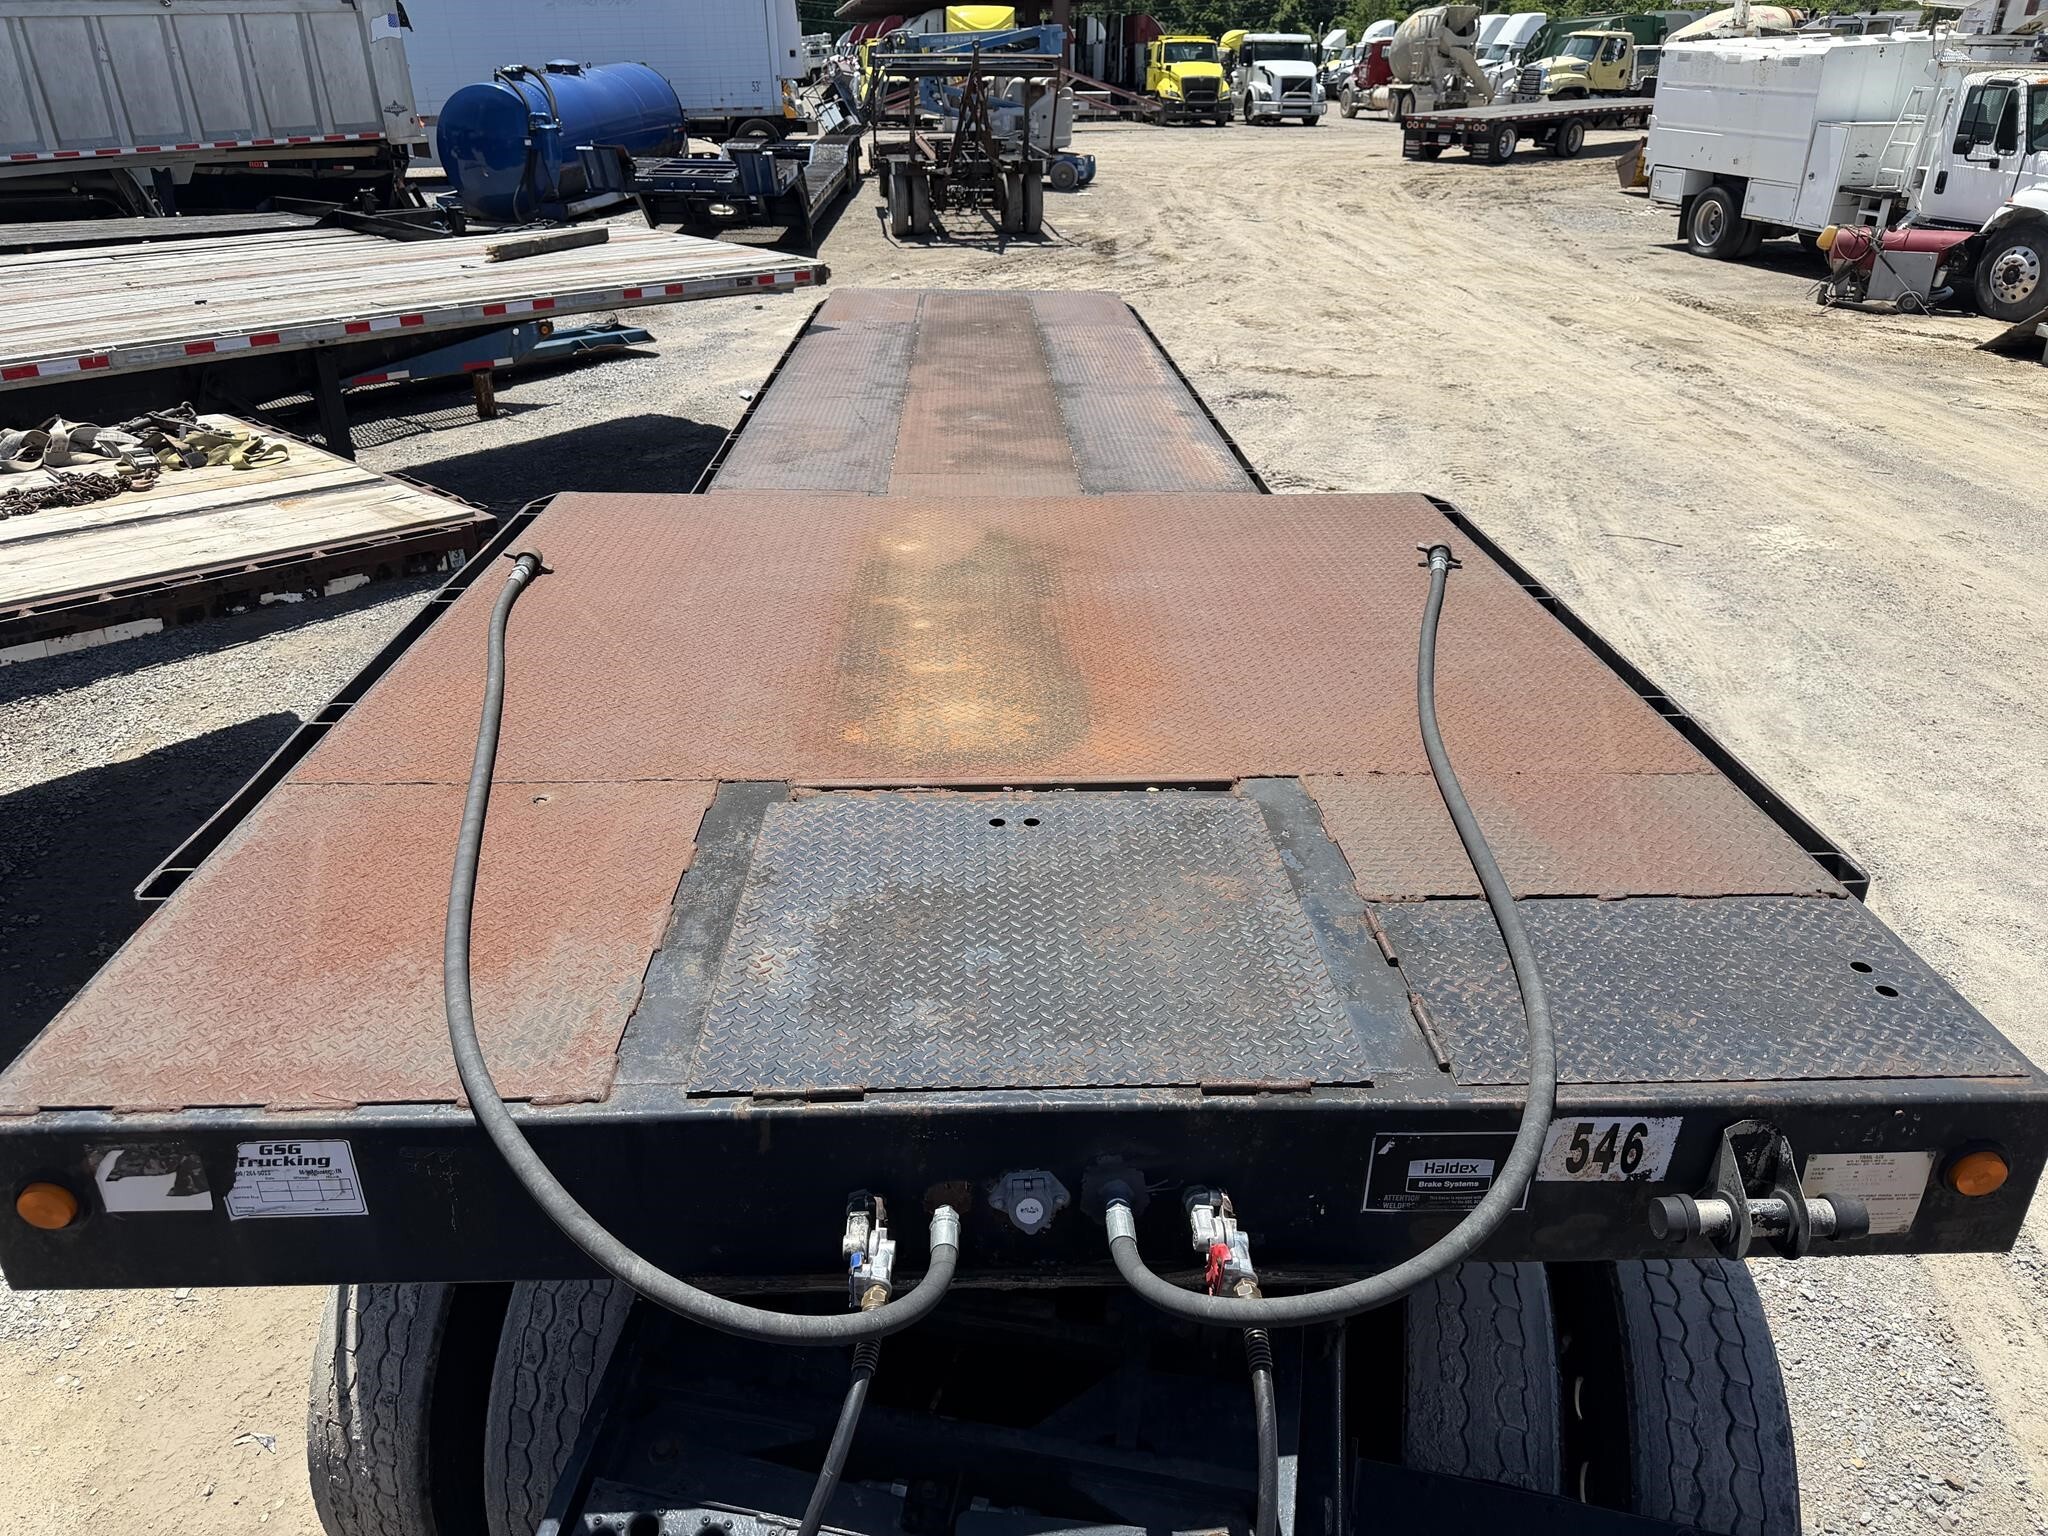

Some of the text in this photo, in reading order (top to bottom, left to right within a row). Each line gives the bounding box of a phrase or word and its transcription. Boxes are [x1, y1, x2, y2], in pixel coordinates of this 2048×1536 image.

[258, 1143, 302, 1155] GSG
[1565, 1122, 1649, 1174] 546
[238, 1155, 331, 1168] Trucking
[1423, 1161, 1479, 1174] Haldex
[1418, 1180, 1479, 1189] Brake Systems
